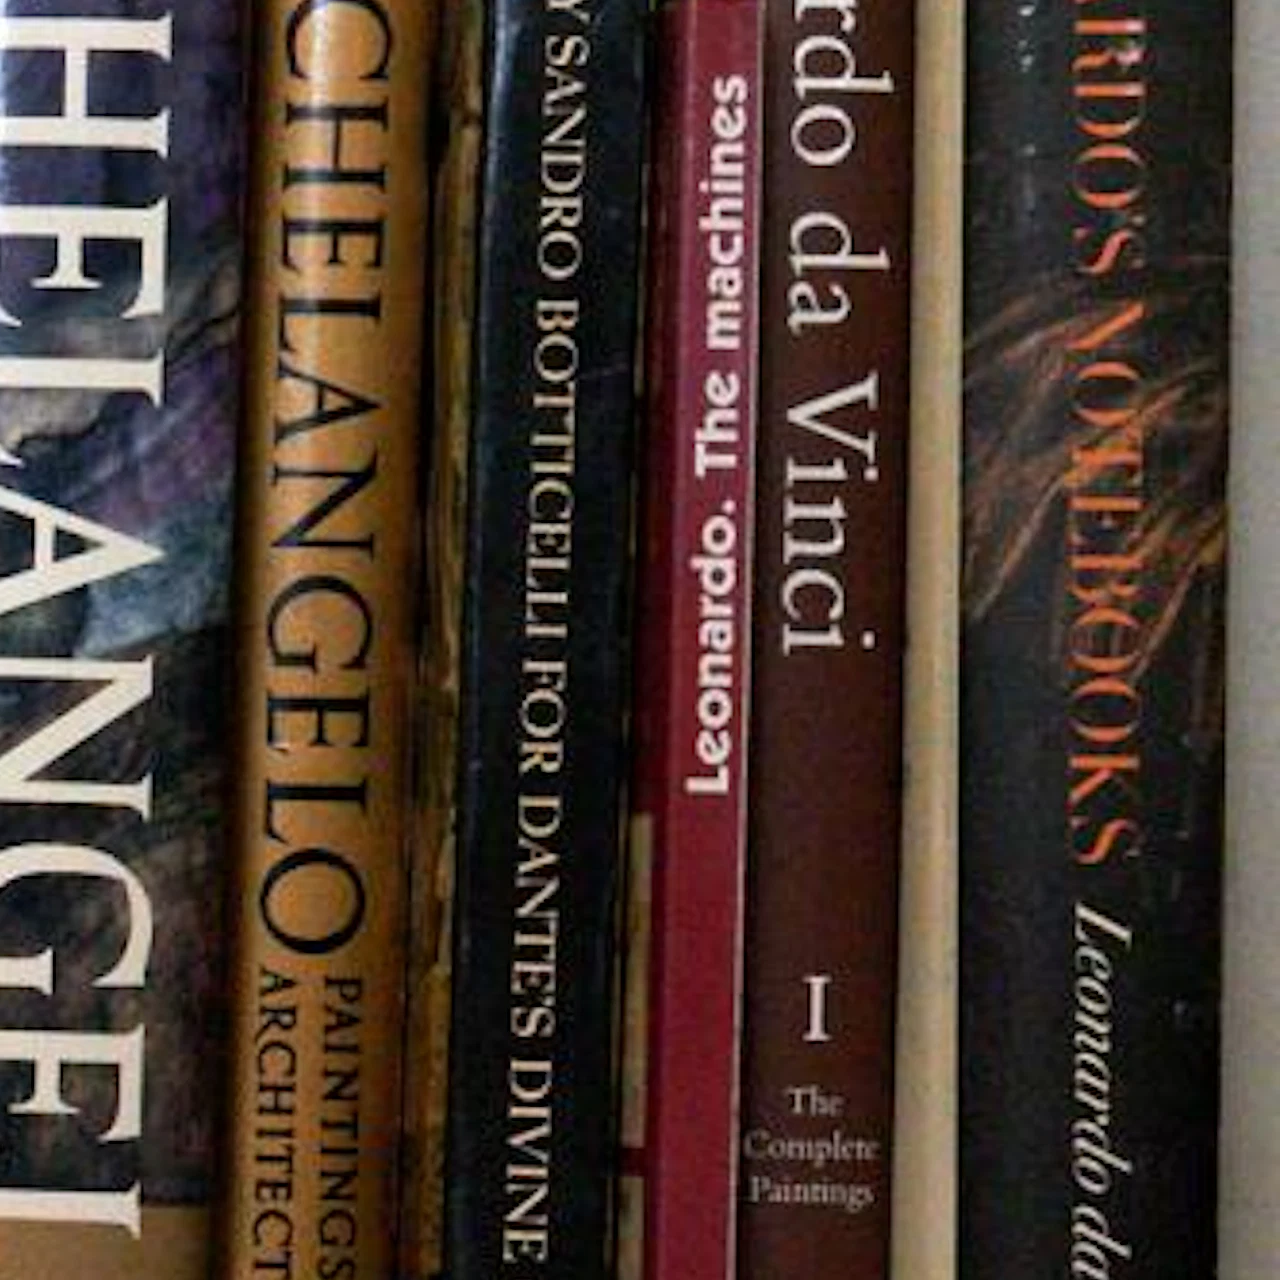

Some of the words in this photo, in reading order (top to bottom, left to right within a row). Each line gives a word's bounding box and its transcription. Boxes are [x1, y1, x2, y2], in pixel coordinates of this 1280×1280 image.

[537, 34, 587, 281] SANDRO
[694, 74, 749, 351] machines
[786, 211, 889, 334] da
[525, 299, 581, 636] BOTTICELLI
[693, 371, 741, 478] The
[782, 371, 879, 655] Vinci
[683, 502, 740, 797] Leonardo.
[1065, 300, 1145, 866] NOTEBOOKS
[519, 657, 567, 774] FOR
[510, 794, 560, 1039] DANTE'S
[802, 974, 834, 1042] I
[501, 1058, 552, 1262] DIVINE
[743, 1129, 881, 1168] Complete
[785, 1084, 845, 1118] The
[1070, 901, 1132, 1197] Leonardo
[749, 1175, 877, 1214] Paintings
